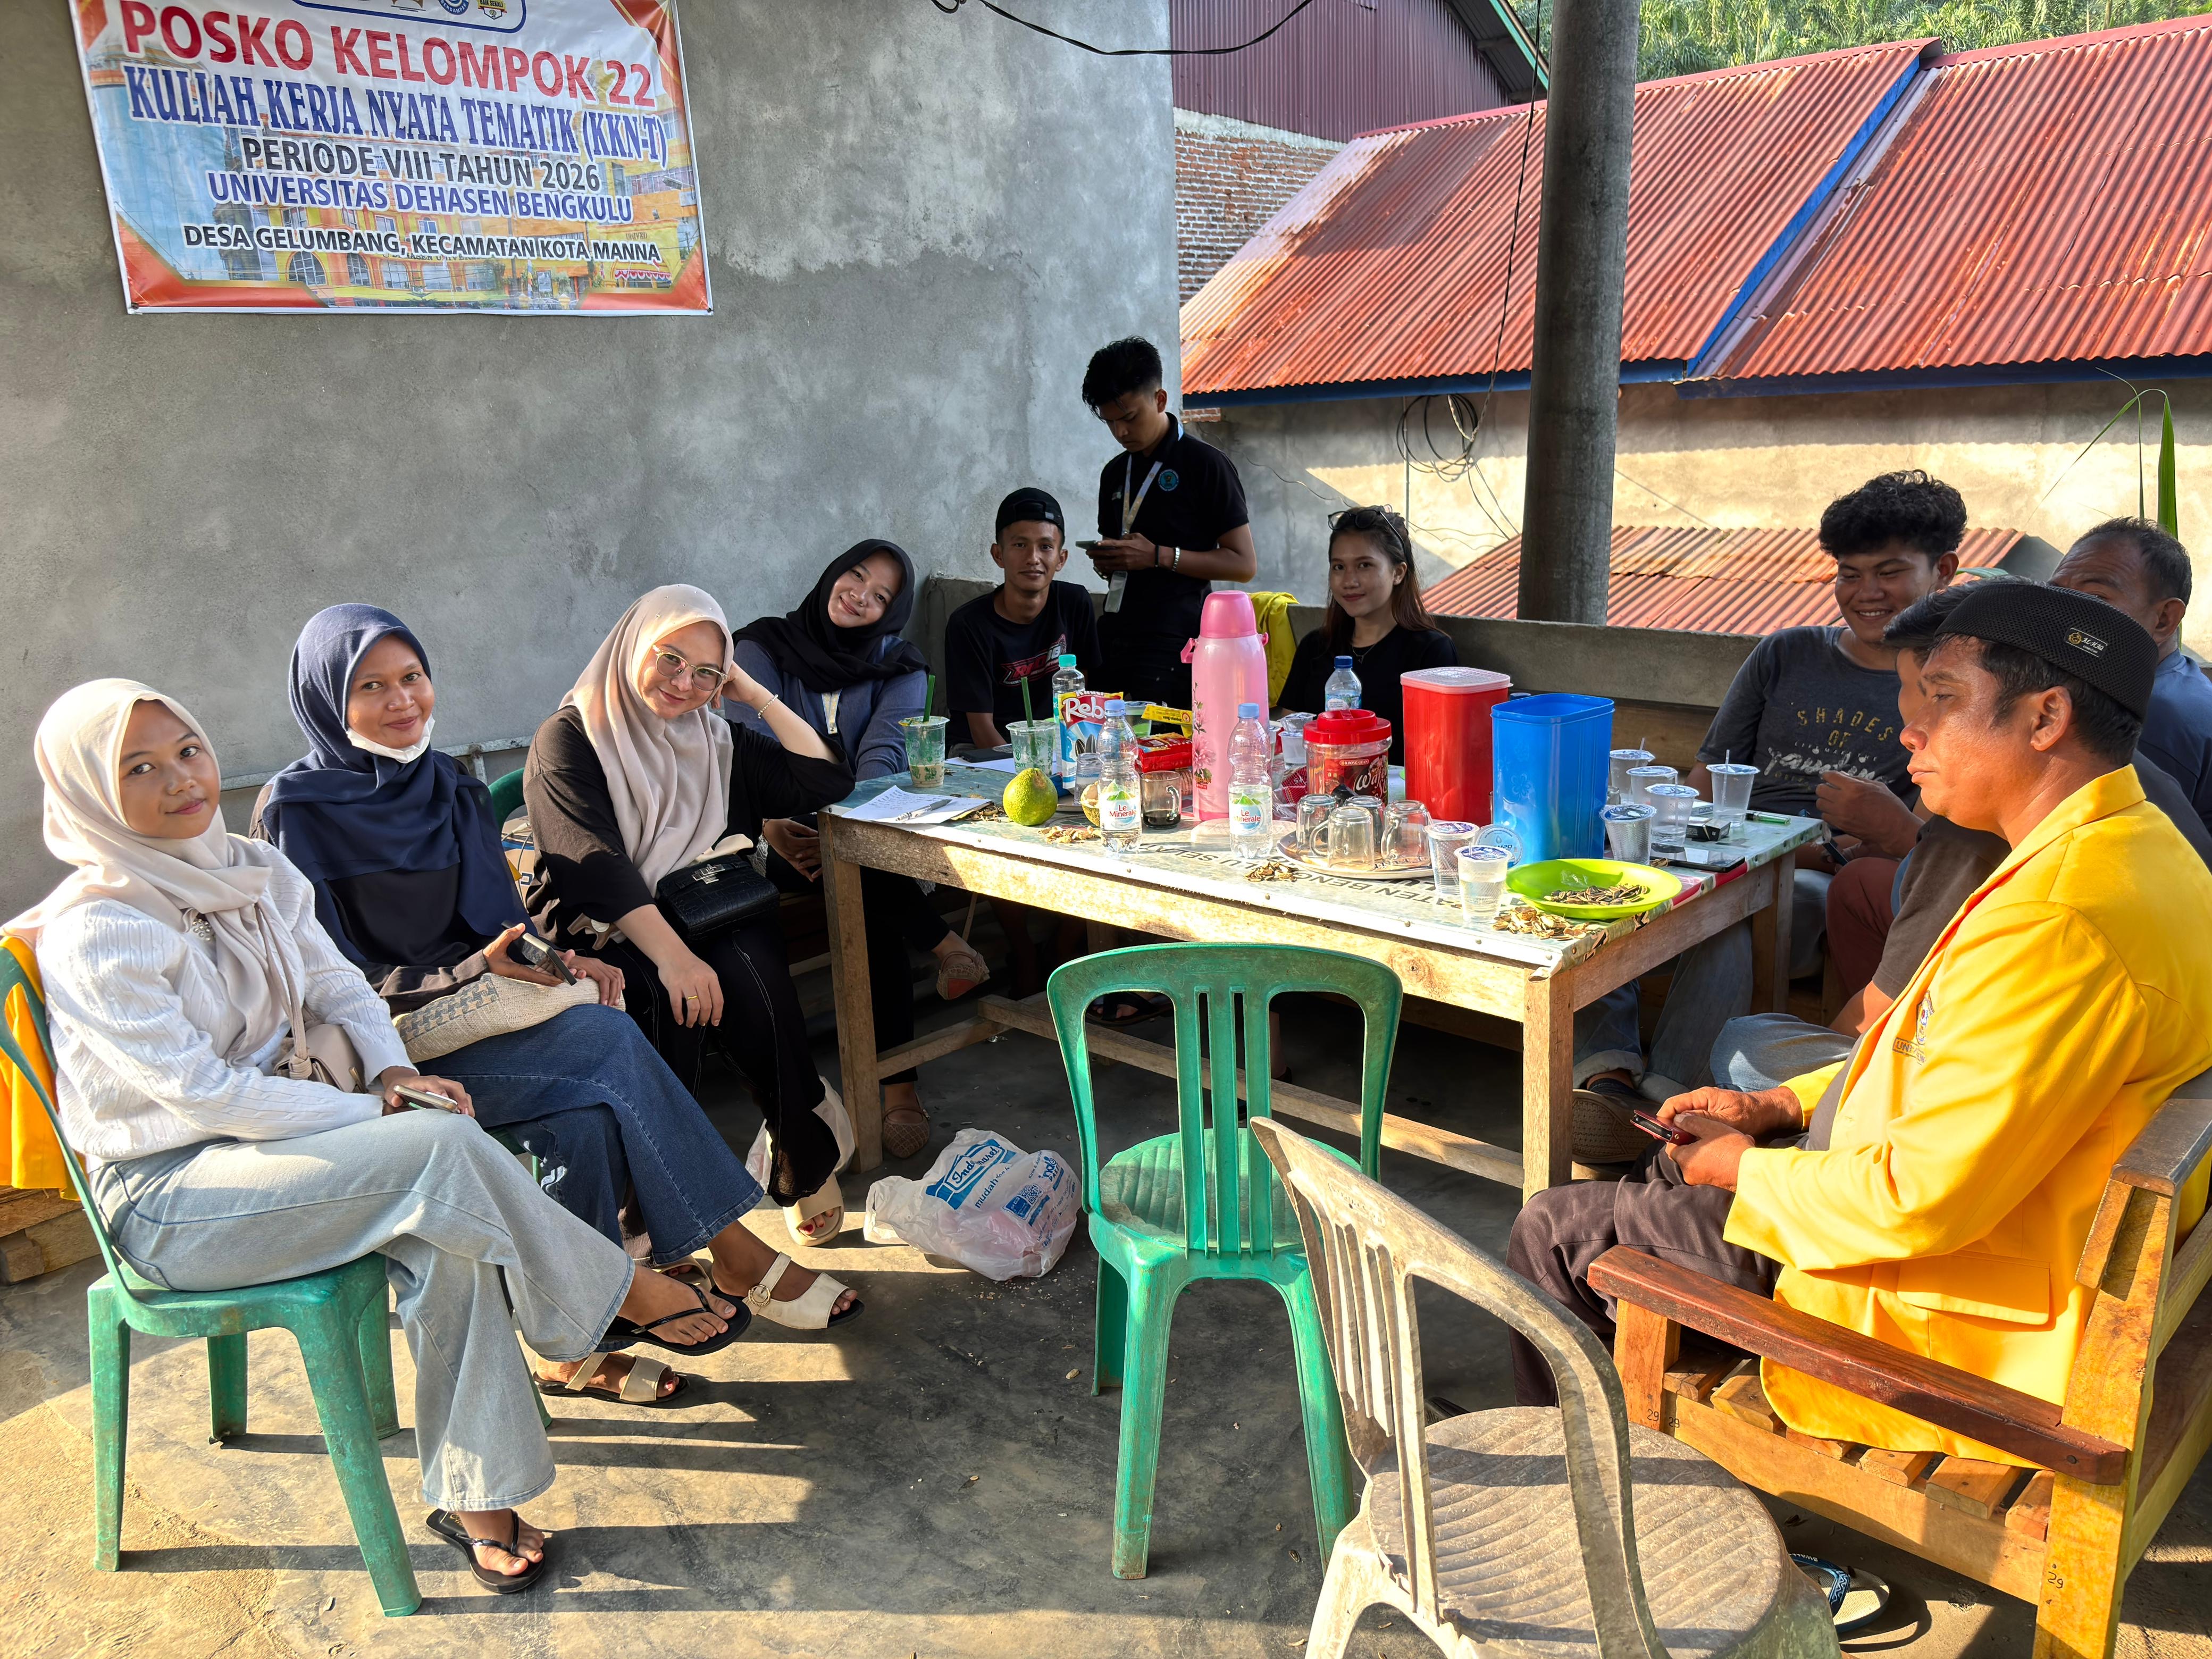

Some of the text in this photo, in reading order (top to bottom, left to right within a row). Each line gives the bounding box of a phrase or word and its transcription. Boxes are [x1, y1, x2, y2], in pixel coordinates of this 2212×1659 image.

[120, 0, 655, 107] POSKO KELOMPOK 22
[124, 65, 667, 170] KULIAH KERJA NYATA TEMATIK (KKN-T)
[242, 138, 600, 192] PERIODE VIII TAHUN 2026
[208, 173, 632, 222] UNIVERSITAS DEHASEN BENGKULU
[183, 225, 660, 261] DESA GELUMBANG, KECAMATAN KOTA MANNA
[1062, 696, 1107, 723] Reb
[1797, 707, 1893, 741] SHADES
[1828, 730, 1853, 748] OF
[974, 1178, 998, 1209] mudah
[2047, 1571, 2064, 1589] 29
